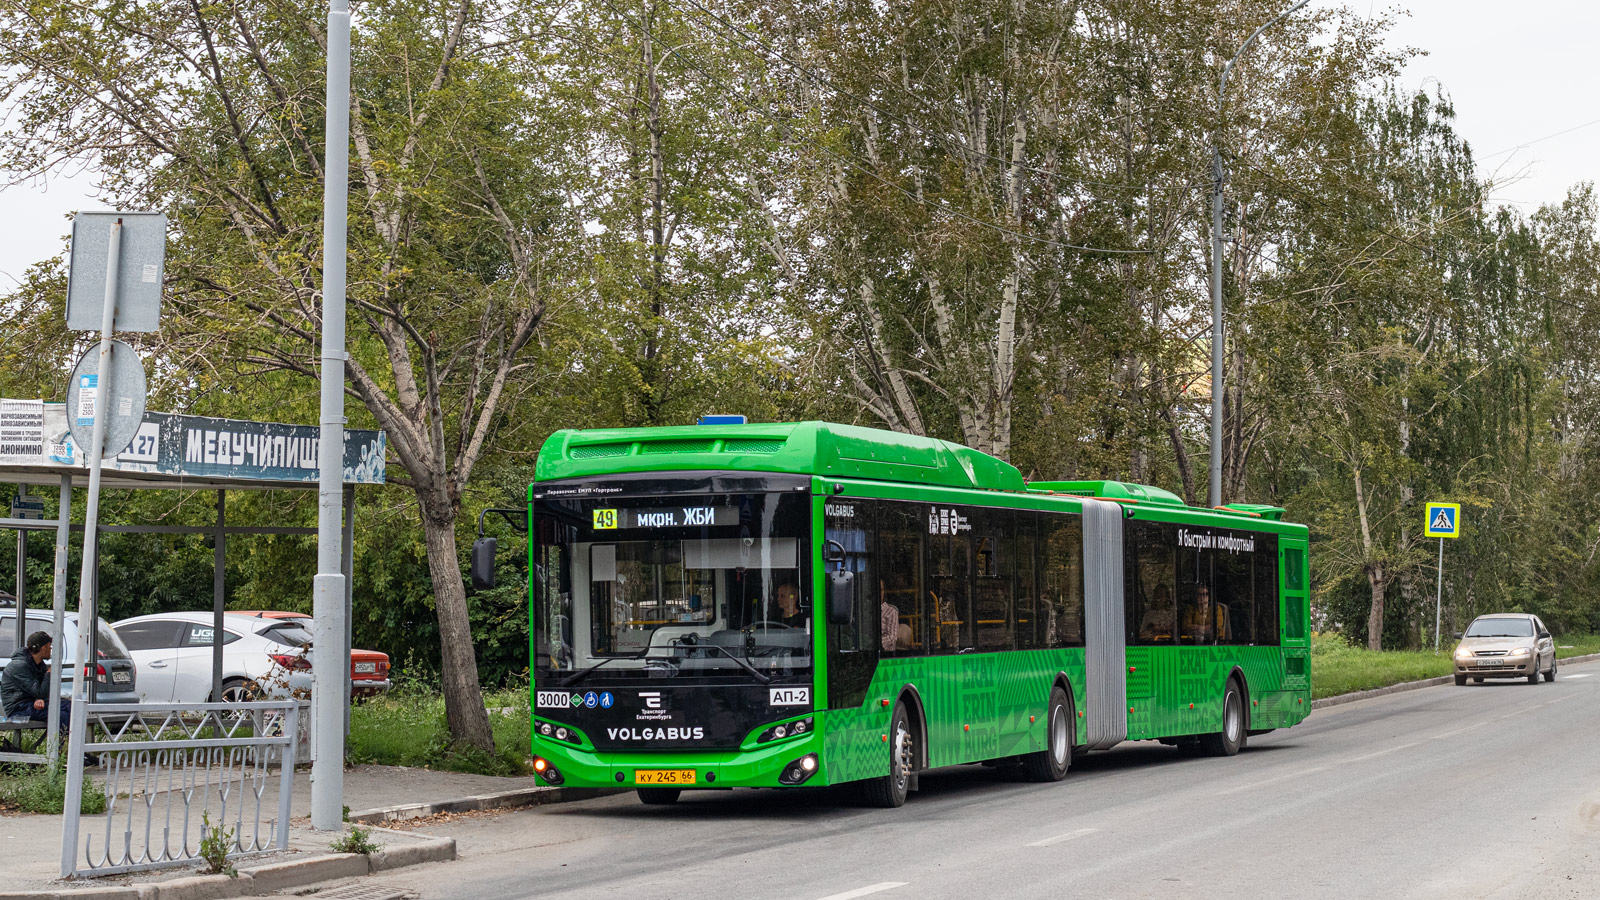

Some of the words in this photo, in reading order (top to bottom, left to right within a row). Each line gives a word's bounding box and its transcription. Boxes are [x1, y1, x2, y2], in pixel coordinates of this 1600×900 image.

[0, 444, 42, 455] АНОНИМНО
[138, 435, 155, 455] 27
[186, 429, 321, 469] МЕДУЧИЛИЩ
[597, 510, 613, 527] 49
[637, 512, 678, 528] мкрн.
[683, 507, 715, 525] ЖБИ
[825, 504, 854, 517] VOLGABUS
[1178, 529, 1183, 546] Я
[1184, 529, 1211, 552] быстрый
[1212, 535, 1216, 548] и
[1218, 532, 1255, 555] комфортный
[961, 656, 995, 689] EKAT
[1179, 649, 1208, 675] EKAT
[539, 693, 568, 706] 3000
[773, 690, 807, 703] АП-2
[1179, 678, 1208, 704] ERIN
[962, 691, 996, 724] ERIN
[1180, 706, 1208, 733] BURG
[607, 727, 704, 741] VOLGABUS
[964, 726, 997, 761] BURG
[657, 772, 677, 783] 245
[681, 771, 692, 780] 66
